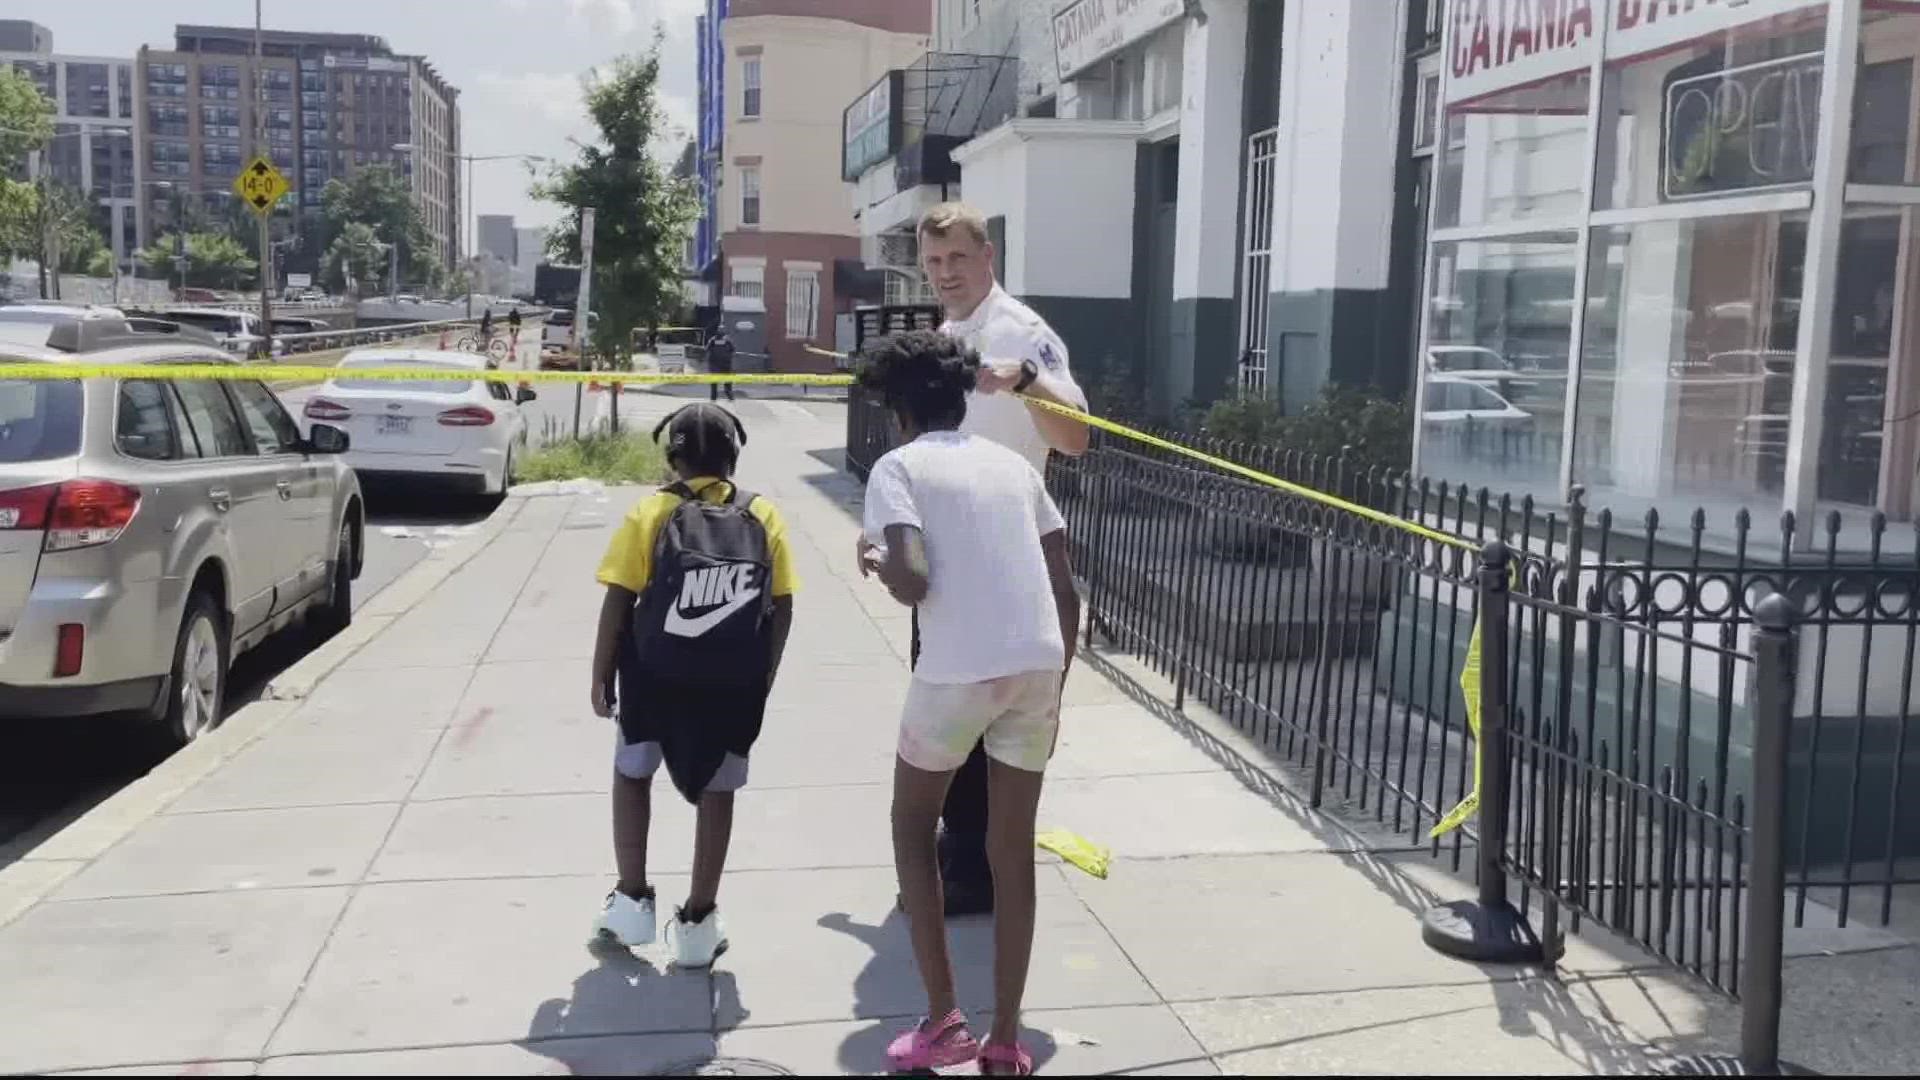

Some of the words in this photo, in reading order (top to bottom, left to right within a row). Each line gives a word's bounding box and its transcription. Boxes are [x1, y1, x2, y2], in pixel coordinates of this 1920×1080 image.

[1451, 0, 1593, 79] CATANIA
[1671, 66, 1820, 184] OPEN
[679, 562, 761, 610] NIKE
